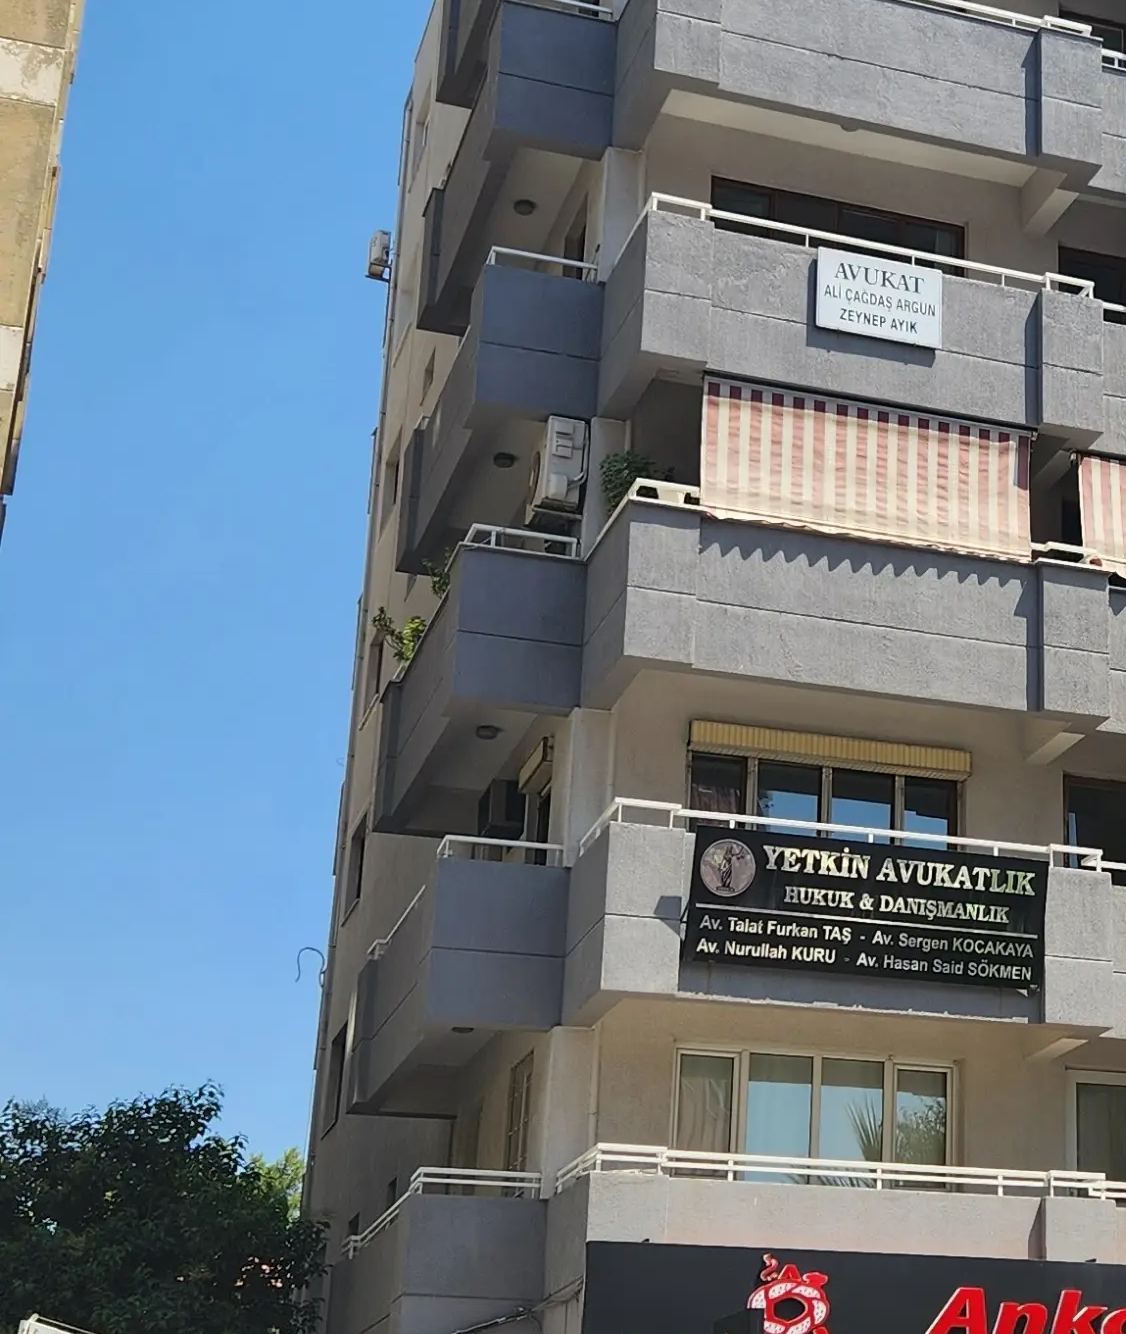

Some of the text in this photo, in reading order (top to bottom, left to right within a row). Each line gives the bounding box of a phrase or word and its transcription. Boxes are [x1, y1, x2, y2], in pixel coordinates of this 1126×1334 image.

[824, 283, 842, 299] ALİ
[834, 262, 925, 294] AVUKAT
[840, 308, 918, 334] ZEYNEP AYIK
[763, 845, 1036, 896] YETKİN AVUKATLIK
[783, 886, 1010, 924] HUKUK & DANIŞMANLIK
[700, 915, 723, 932] Av.
[728, 917, 764, 935] Talat
[767, 921, 818, 940] Furkan
[822, 926, 852, 945] TAŞ
[872, 930, 895, 947] Av.
[898, 932, 948, 953] Sergen
[952, 938, 1034, 959] KOCAKAYA
[696, 938, 720, 955] Av.
[724, 941, 787, 960] Nurullah
[791, 945, 836, 964] KURU
[856, 952, 879, 968] Av.
[883, 955, 929, 972] Hasan
[932, 957, 964, 976] Said
[967, 959, 1032, 981] SÖKMEN
